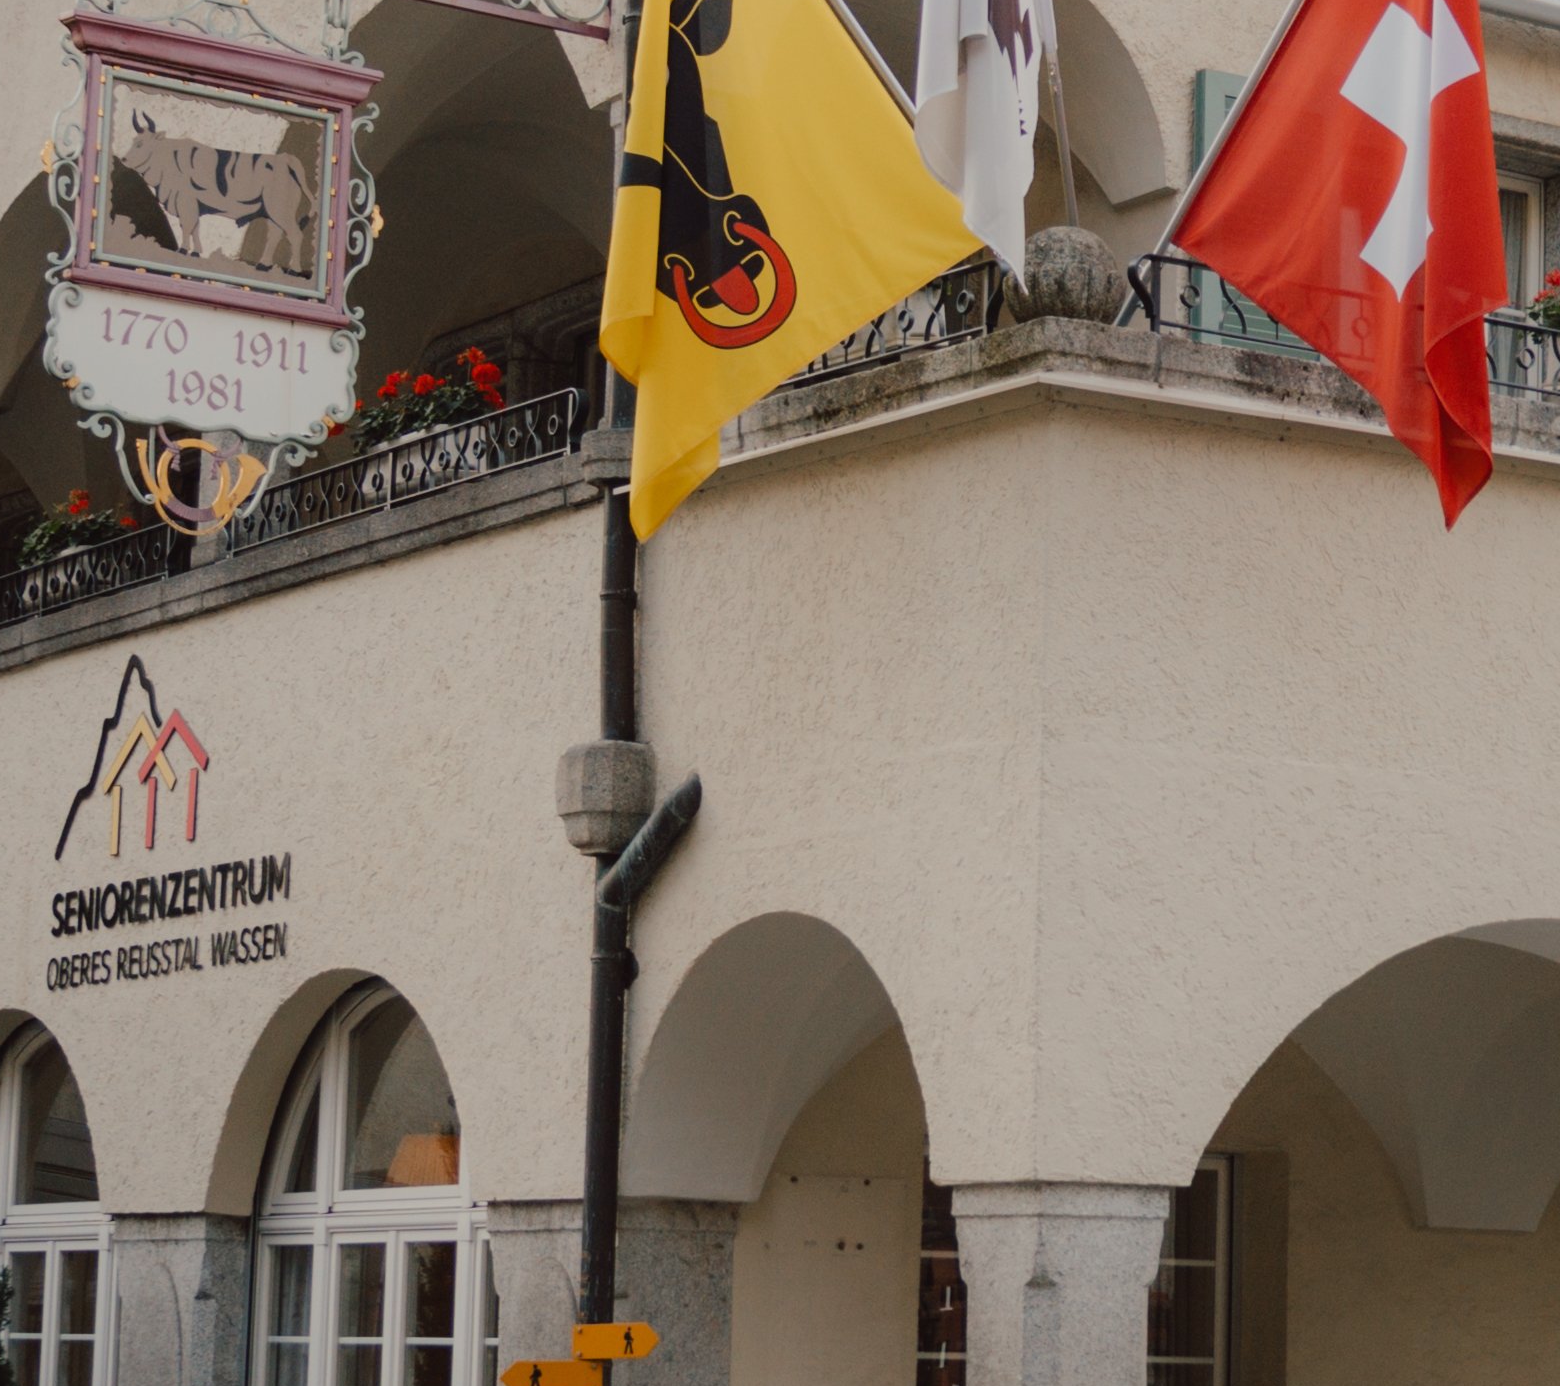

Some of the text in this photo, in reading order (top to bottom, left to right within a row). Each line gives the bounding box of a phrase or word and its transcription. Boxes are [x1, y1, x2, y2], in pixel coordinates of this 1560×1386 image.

[101, 306, 309, 375] 1770 1911
[165, 368, 246, 413] 1981
[51, 851, 291, 938] SENIORENZENTRUM
[46, 921, 287, 991] OBERES REUSSTAL WASSEN
